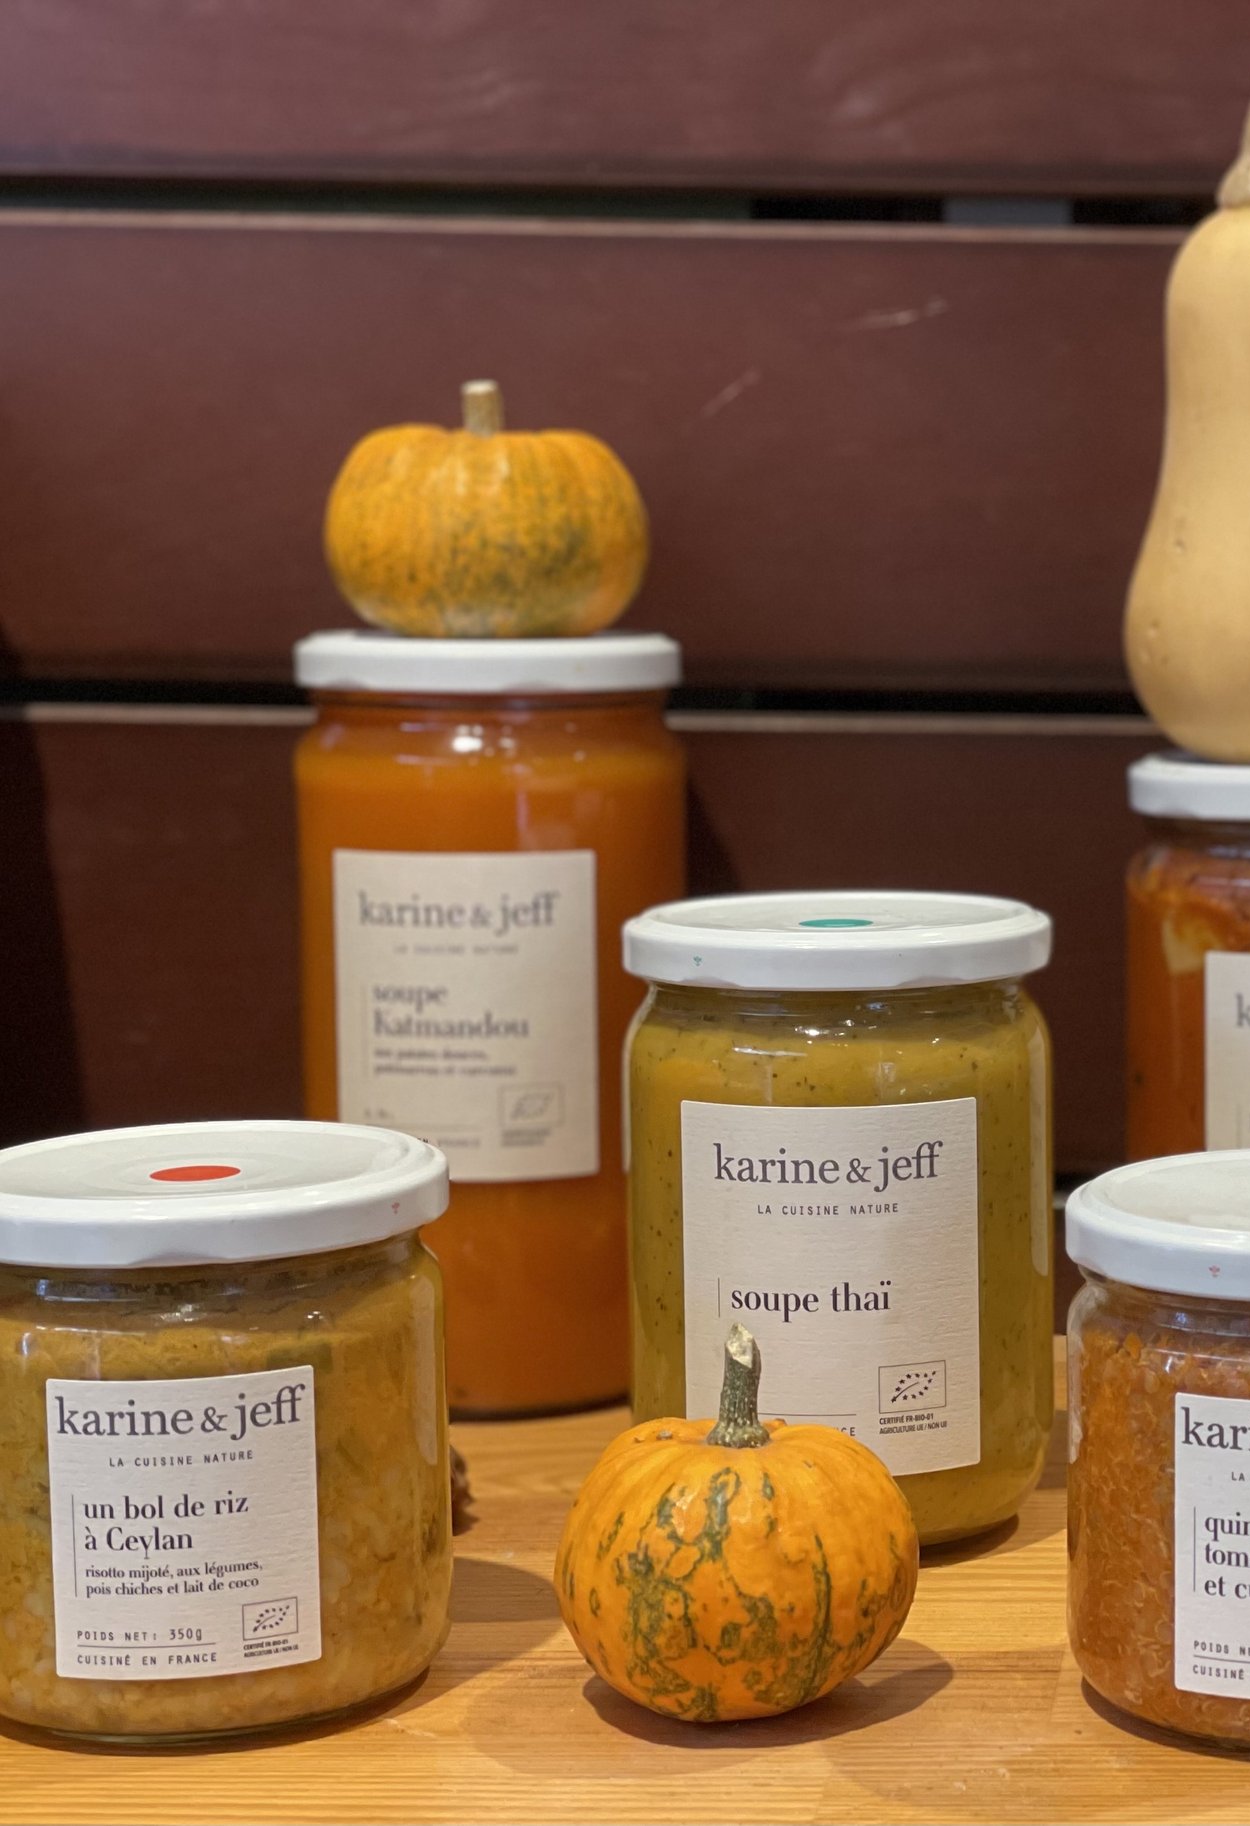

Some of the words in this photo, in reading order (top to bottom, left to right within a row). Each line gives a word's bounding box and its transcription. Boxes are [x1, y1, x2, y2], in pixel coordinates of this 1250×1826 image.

[358, 890, 467, 927] karine
[469, 906, 493, 929] &
[493, 890, 561, 938] jeff
[373, 986, 448, 1014] soupe
[713, 1142, 840, 1184] karine
[846, 1157, 872, 1184] &
[873, 1140, 944, 1193] jeff
[757, 1204, 772, 1215] LA
[781, 1204, 839, 1216] CUISINE
[850, 1202, 899, 1215] NATURE
[731, 1288, 820, 1323] soupe
[830, 1280, 892, 1312] thaï
[54, 1395, 194, 1436] karine
[200, 1406, 228, 1432] &
[229, 1383, 306, 1441] jeff
[879, 1415, 905, 1425] CERTIFIÉ
[879, 1425, 915, 1435] AGRICULTURE
[109, 1457, 125, 1467] LA
[134, 1455, 193, 1467] CUISINE
[203, 1450, 254, 1464] NATURE
[1231, 1472, 1245, 1482] LA
[83, 1502, 114, 1519] un
[124, 1495, 164, 1519] bol
[173, 1493, 205, 1518] de
[214, 1490, 249, 1515] riz
[84, 1526, 97, 1551] à
[106, 1525, 193, 1560] Ceylan
[85, 1566, 125, 1579] risotto
[128, 1564, 174, 1582] mijoté,
[176, 1565, 200, 1577] aux
[204, 1559, 263, 1578] légumes,
[86, 1583, 111, 1599] pois
[114, 1580, 163, 1595] chiches
[166, 1580, 180, 1594] et
[183, 1580, 204, 1593] lait
[208, 1577, 225, 1591] de
[228, 1576, 259, 1588] coco
[1204, 1576, 1226, 1597] et
[77, 1630, 114, 1642] POIDS
[124, 1630, 158, 1641] NET:
[169, 1628, 203, 1641] 350g
[1193, 1640, 1230, 1655] POIDS
[77, 1651, 131, 1666] CUISINÉ
[142, 1655, 157, 1666] EN
[168, 1652, 218, 1664] FRANCE
[1192, 1664, 1245, 1681] CUISINÉ
